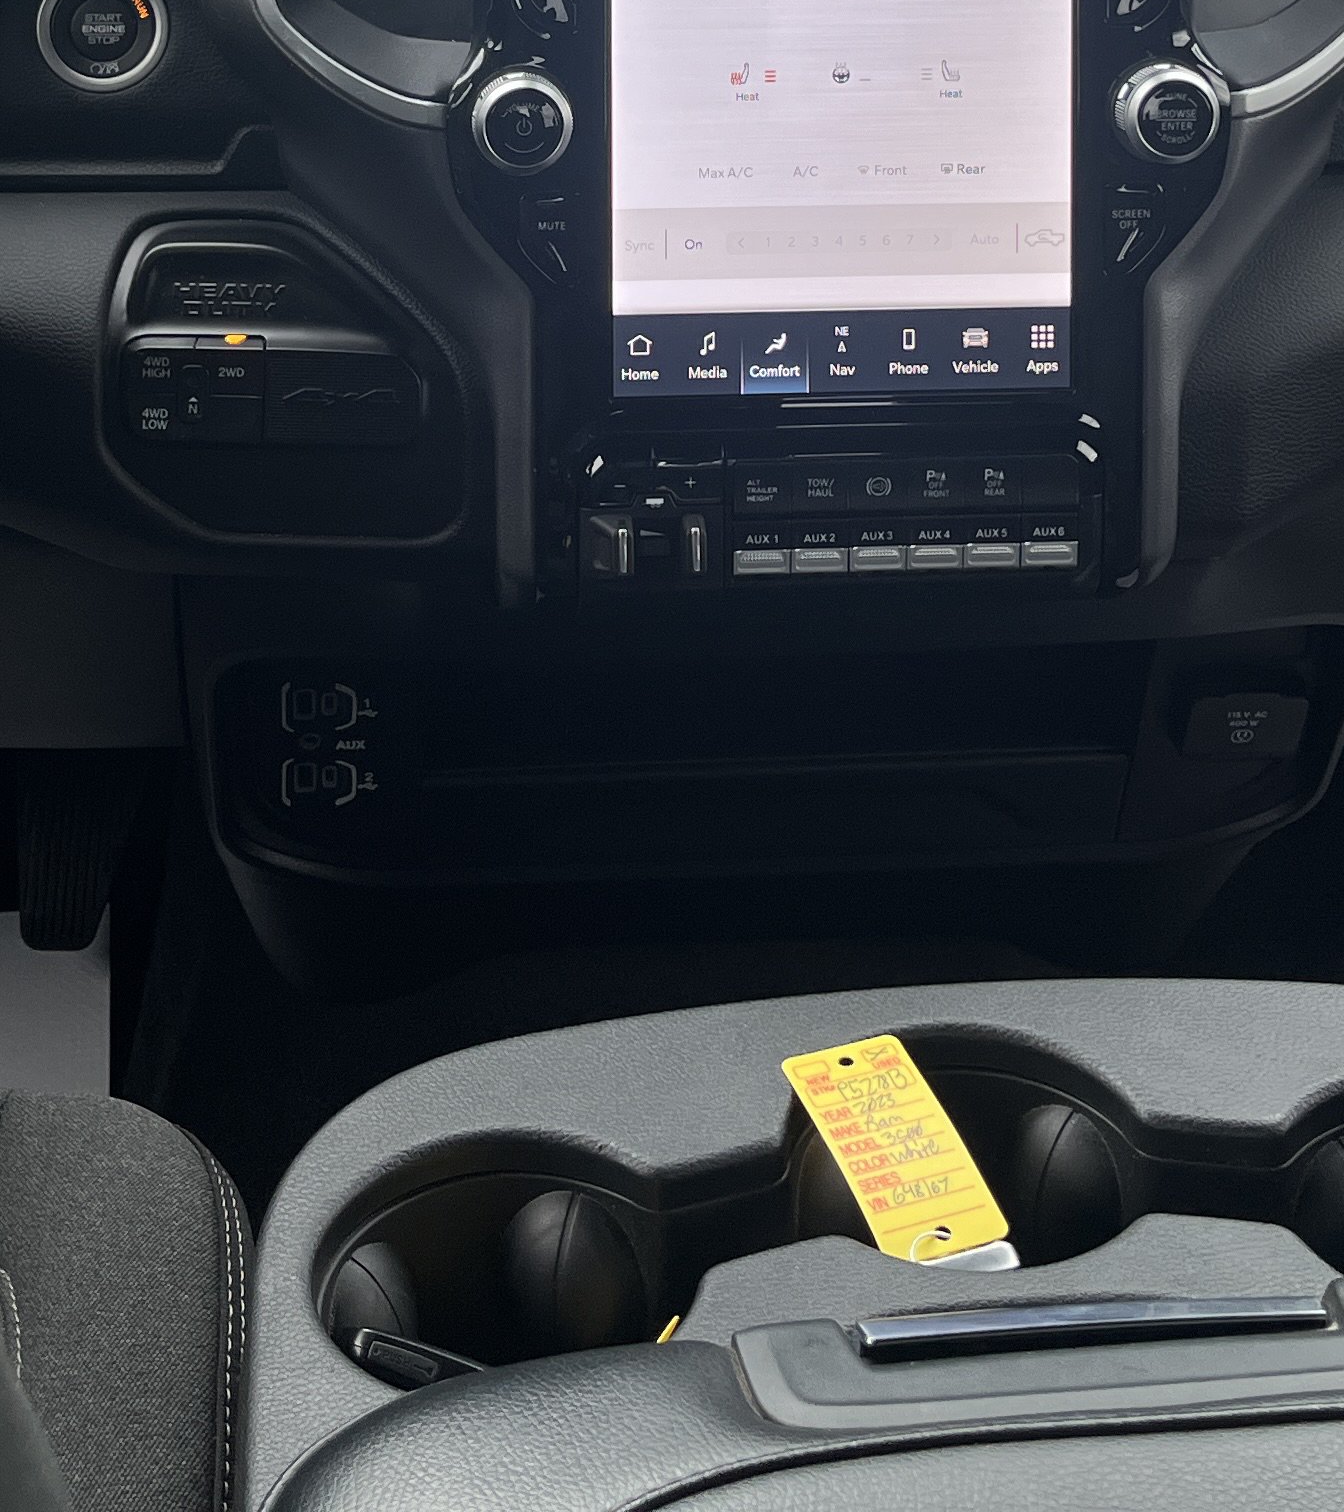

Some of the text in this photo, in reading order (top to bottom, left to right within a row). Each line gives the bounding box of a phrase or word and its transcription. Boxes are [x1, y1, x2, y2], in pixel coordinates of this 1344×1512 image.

[85, 13, 123, 22] START
[81, 24, 126, 33] ENGINE
[87, 36, 121, 45] STOP
[735, 91, 760, 102] Heat
[939, 89, 963, 99] Heat
[1157, 109, 1197, 118] BROWSE
[1161, 121, 1194, 131] ENTER
[698, 166, 754, 179] Max A/C
[793, 165, 819, 178] A/C
[874, 165, 908, 176] Front
[956, 164, 986, 175] Rear
[1111, 208, 1151, 219] SCREEN
[537, 220, 566, 231] MUTE
[684, 238, 703, 250] On
[834, 325, 850, 337] NE
[143, 356, 170, 367] 4WD
[888, 360, 929, 375] Phone
[951, 359, 1000, 374] Vehicle
[1025, 359, 1059, 375] Apps
[142, 367, 171, 378] HIGH
[218, 367, 245, 378] 2WD
[621, 368, 660, 381] Home
[688, 365, 728, 379] Media
[749, 363, 801, 378] Comfort
[829, 363, 856, 376] Nav
[141, 407, 169, 419] 4WD
[187, 403, 198, 415] N
[142, 419, 169, 430] LOW
[807, 488, 835, 498] HAUL
[923, 489, 950, 498] FRONT
[984, 488, 1006, 496] REAR
[335, 739, 367, 750] AUX
[853, 1093, 896, 1115] 2023
[819, 1106, 855, 1122] YEAR
[829, 1123, 866, 1141] MAKE
[838, 1137, 882, 1157] MODEL
[848, 1153, 892, 1174] COLOR
[857, 1171, 902, 1195] SERIES
[866, 1195, 890, 1212] VIN
